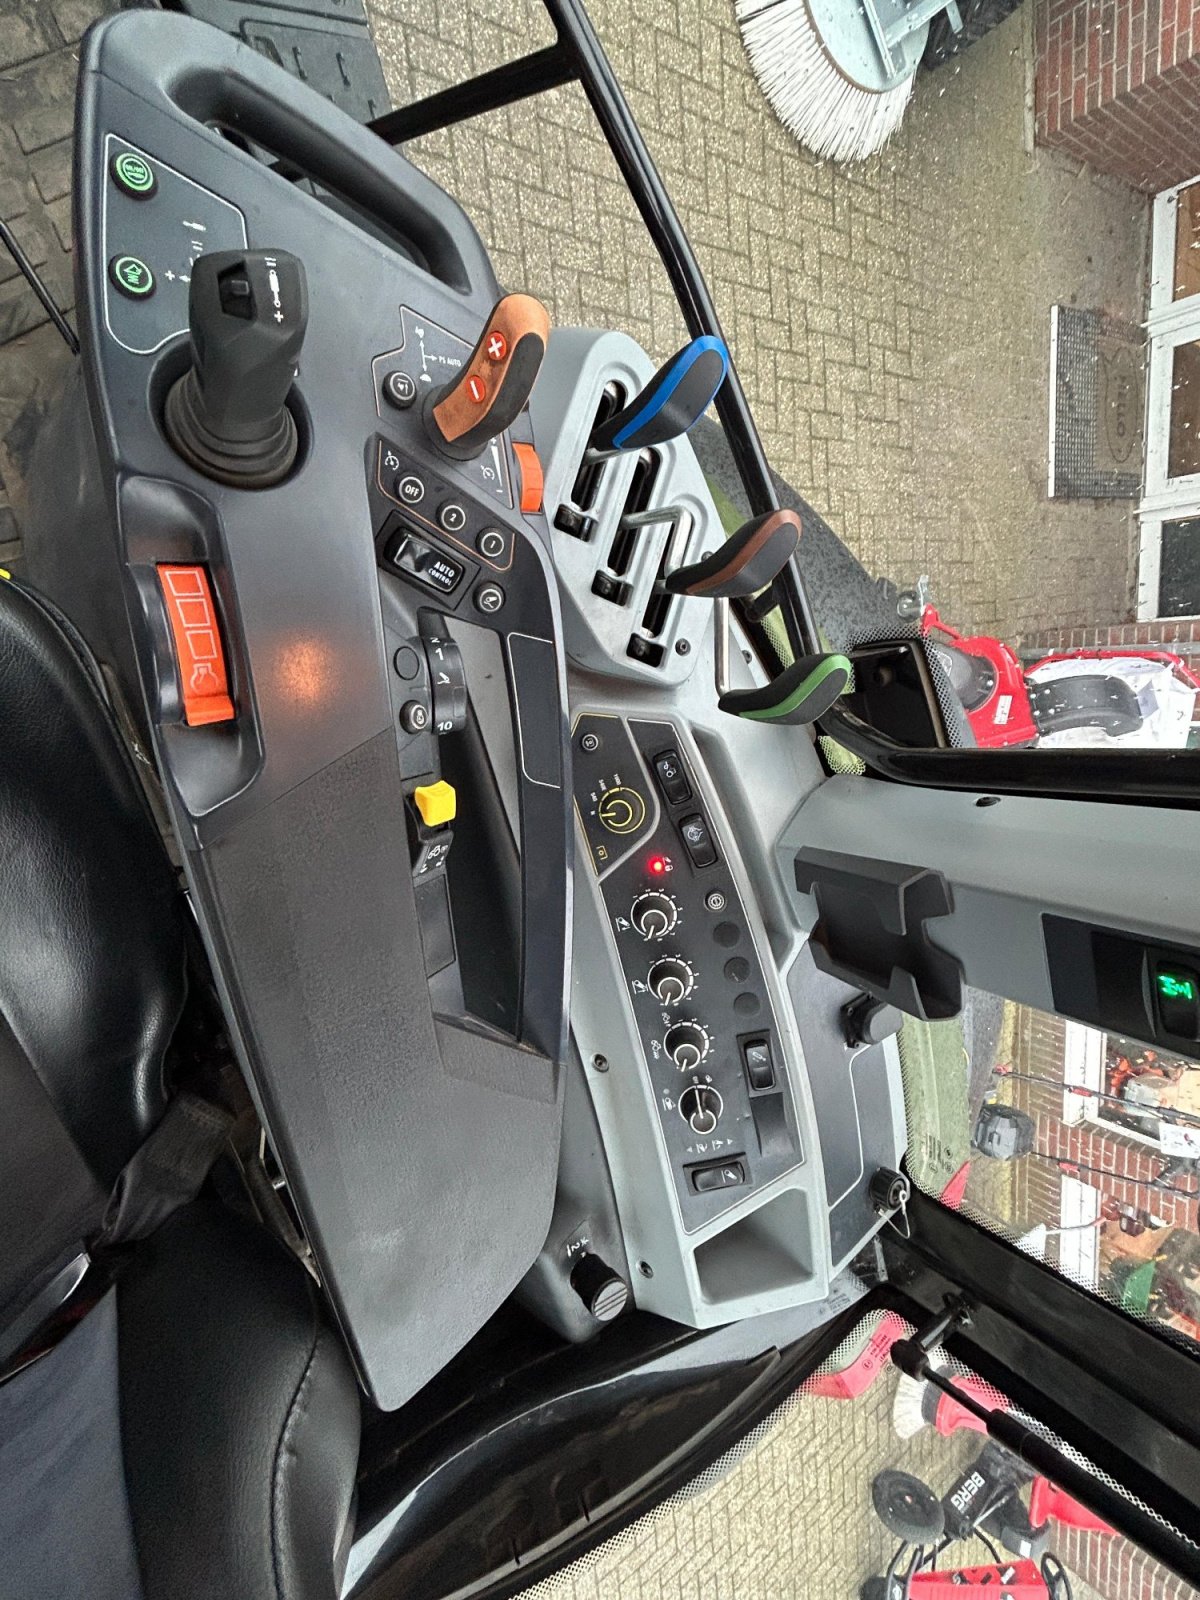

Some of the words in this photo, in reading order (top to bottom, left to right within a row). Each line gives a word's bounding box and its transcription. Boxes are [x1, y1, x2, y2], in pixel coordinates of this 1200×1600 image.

[404, 483, 420, 497] OFF
[450, 513, 457, 522] 2
[489, 540, 496, 549] 1
[434, 560, 455, 578] AUTO
[428, 567, 452, 586] CONTROL
[435, 647, 444, 660] 1
[436, 720, 453, 732] 10
[953, 1471, 986, 1511] BERG
